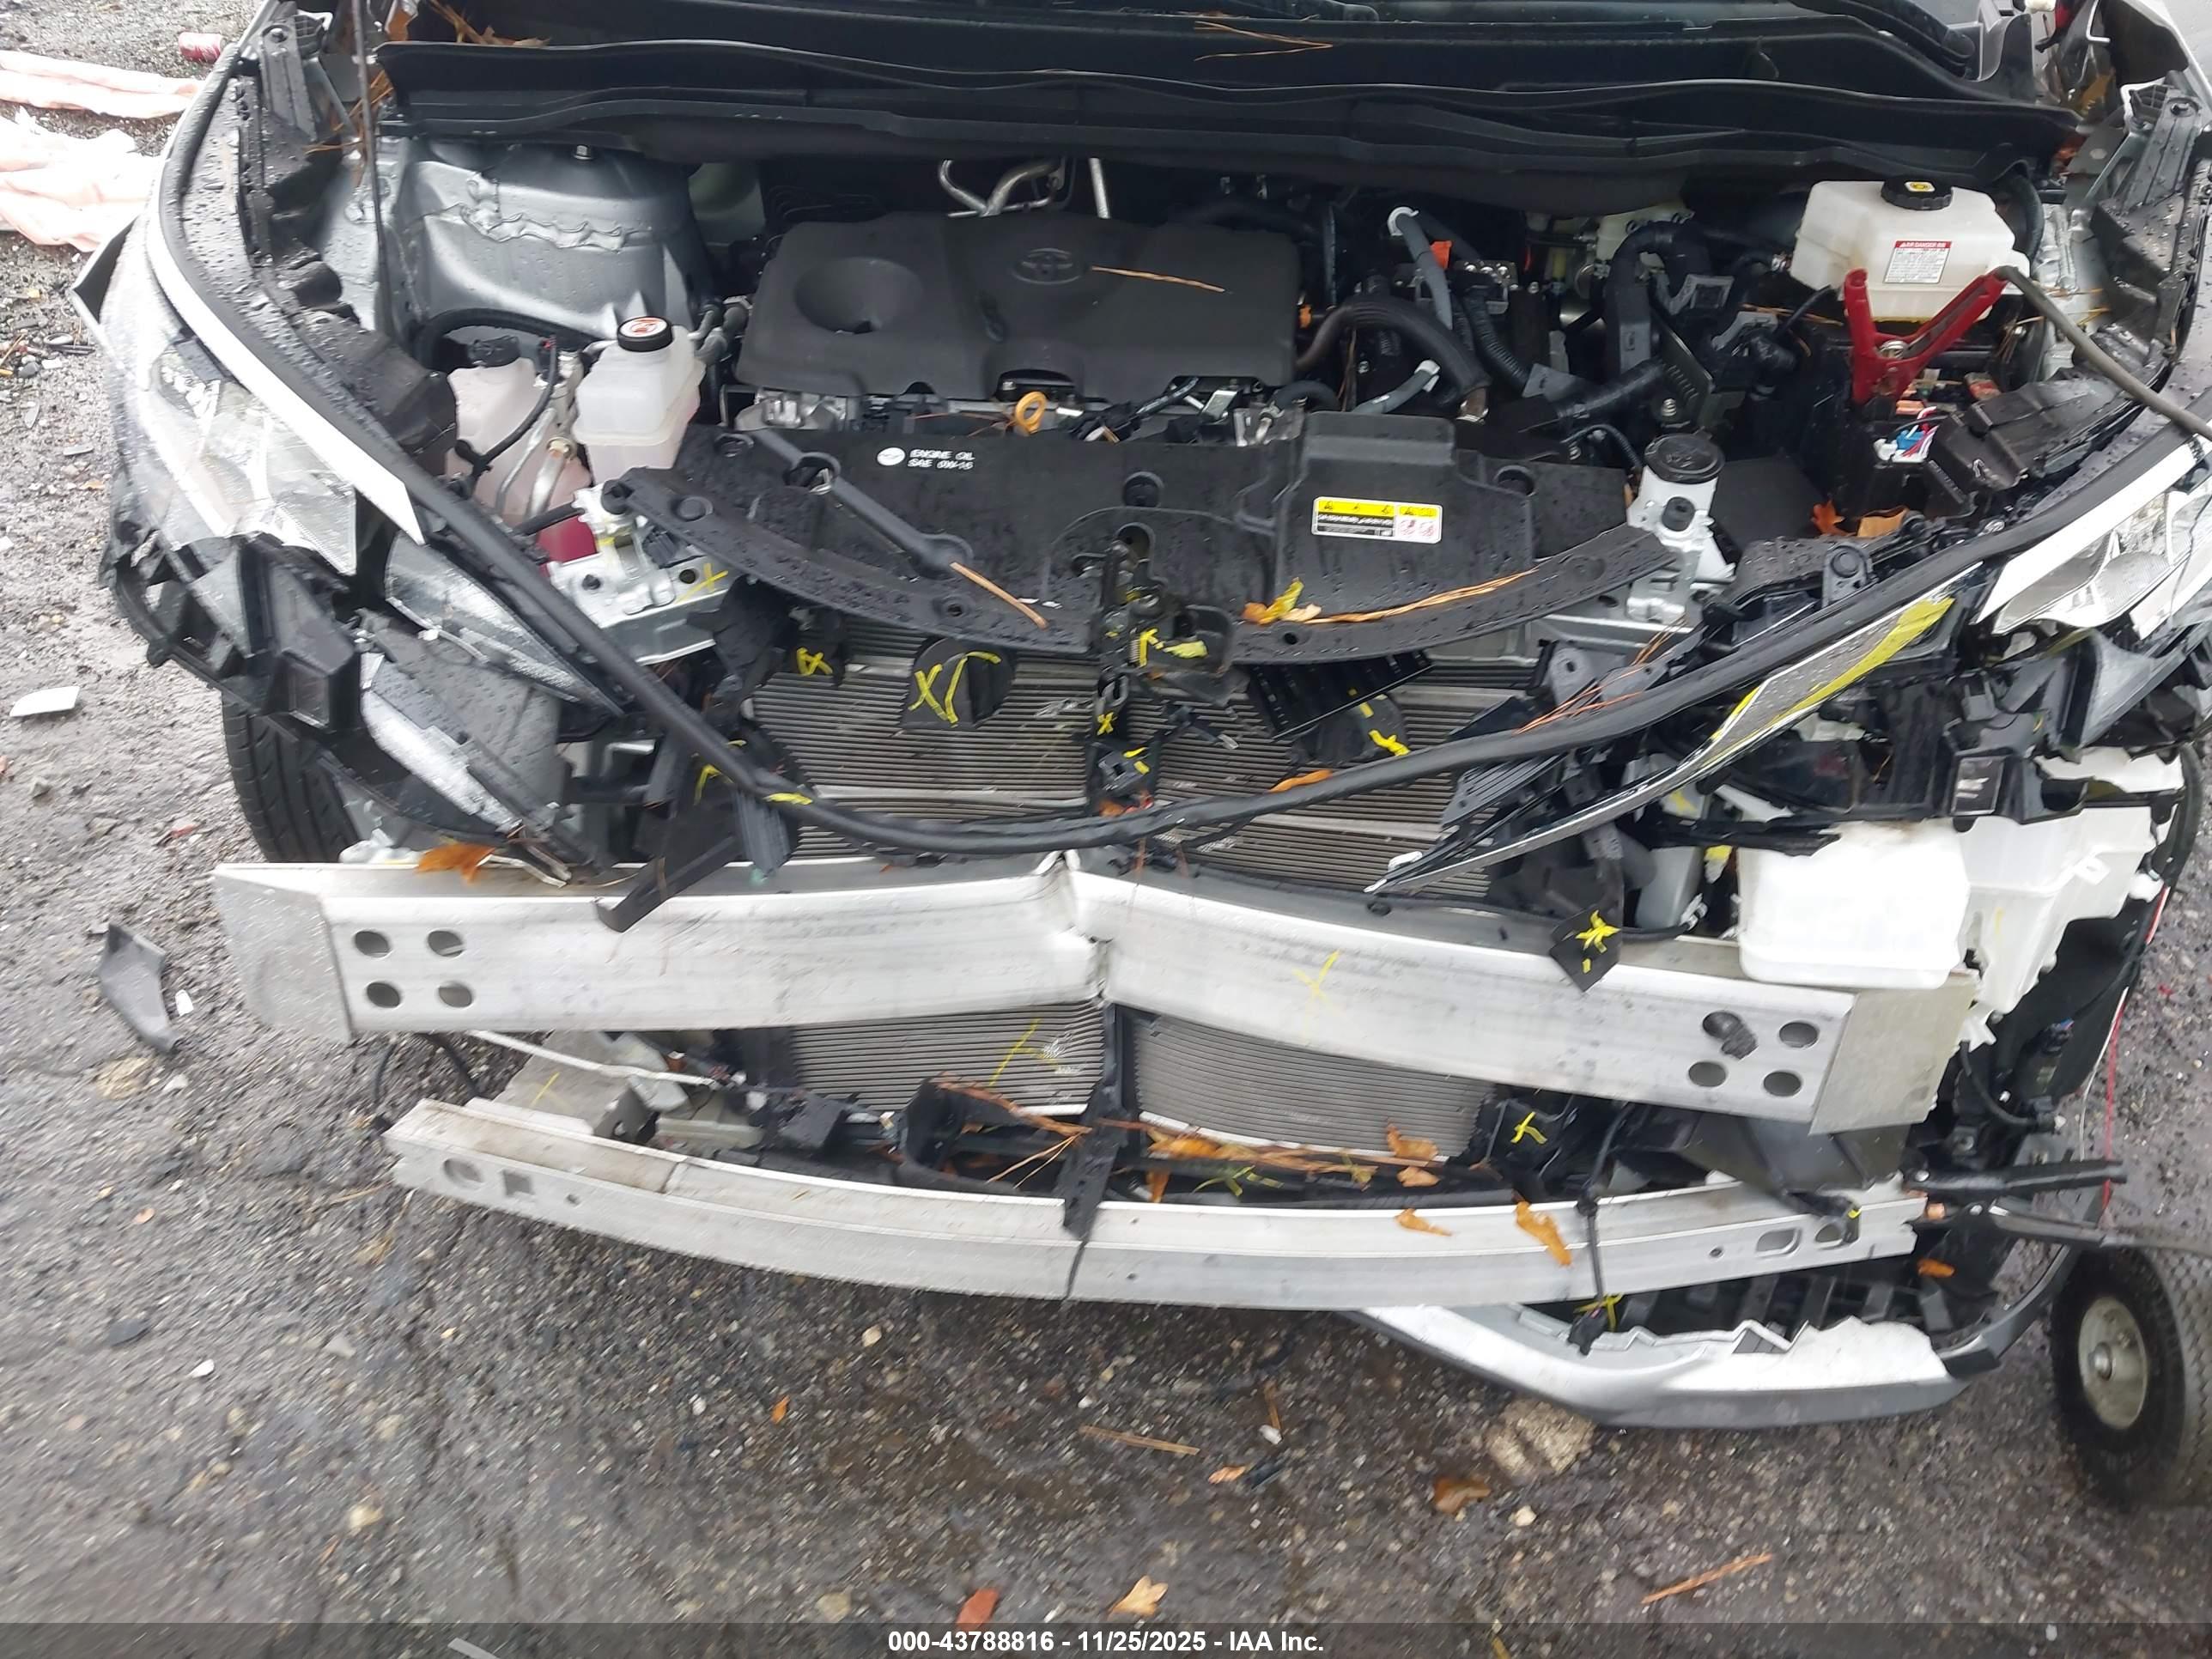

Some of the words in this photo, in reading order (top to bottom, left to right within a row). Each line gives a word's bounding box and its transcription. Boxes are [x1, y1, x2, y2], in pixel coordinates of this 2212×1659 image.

[910, 449, 952, 459] ENGINE
[955, 452, 975, 461] OIL
[908, 458, 933, 468] SAE
